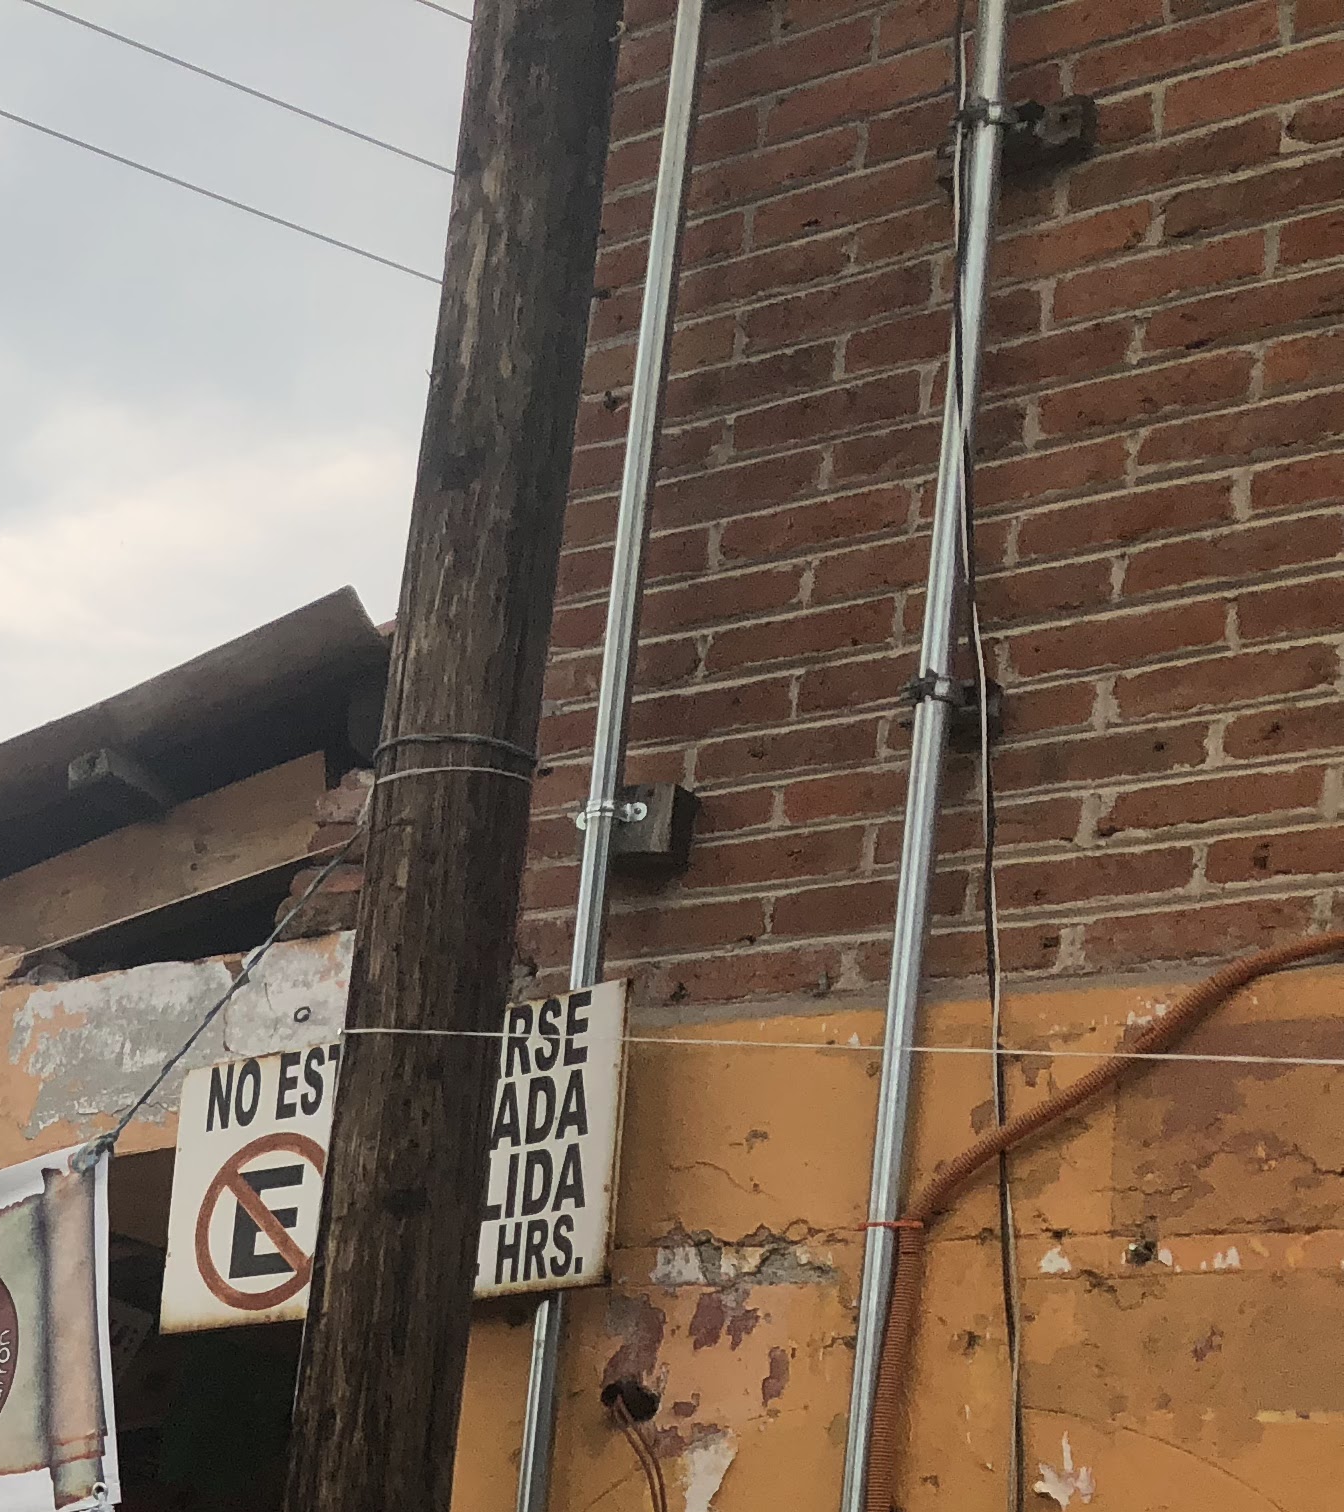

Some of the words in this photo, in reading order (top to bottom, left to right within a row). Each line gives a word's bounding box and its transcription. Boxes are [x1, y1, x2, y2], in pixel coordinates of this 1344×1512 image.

[504, 990, 592, 1079] RSE
[206, 1057, 262, 1132] NO
[491, 1068, 589, 1150] ADA
[494, 1213, 584, 1285] HRS.
